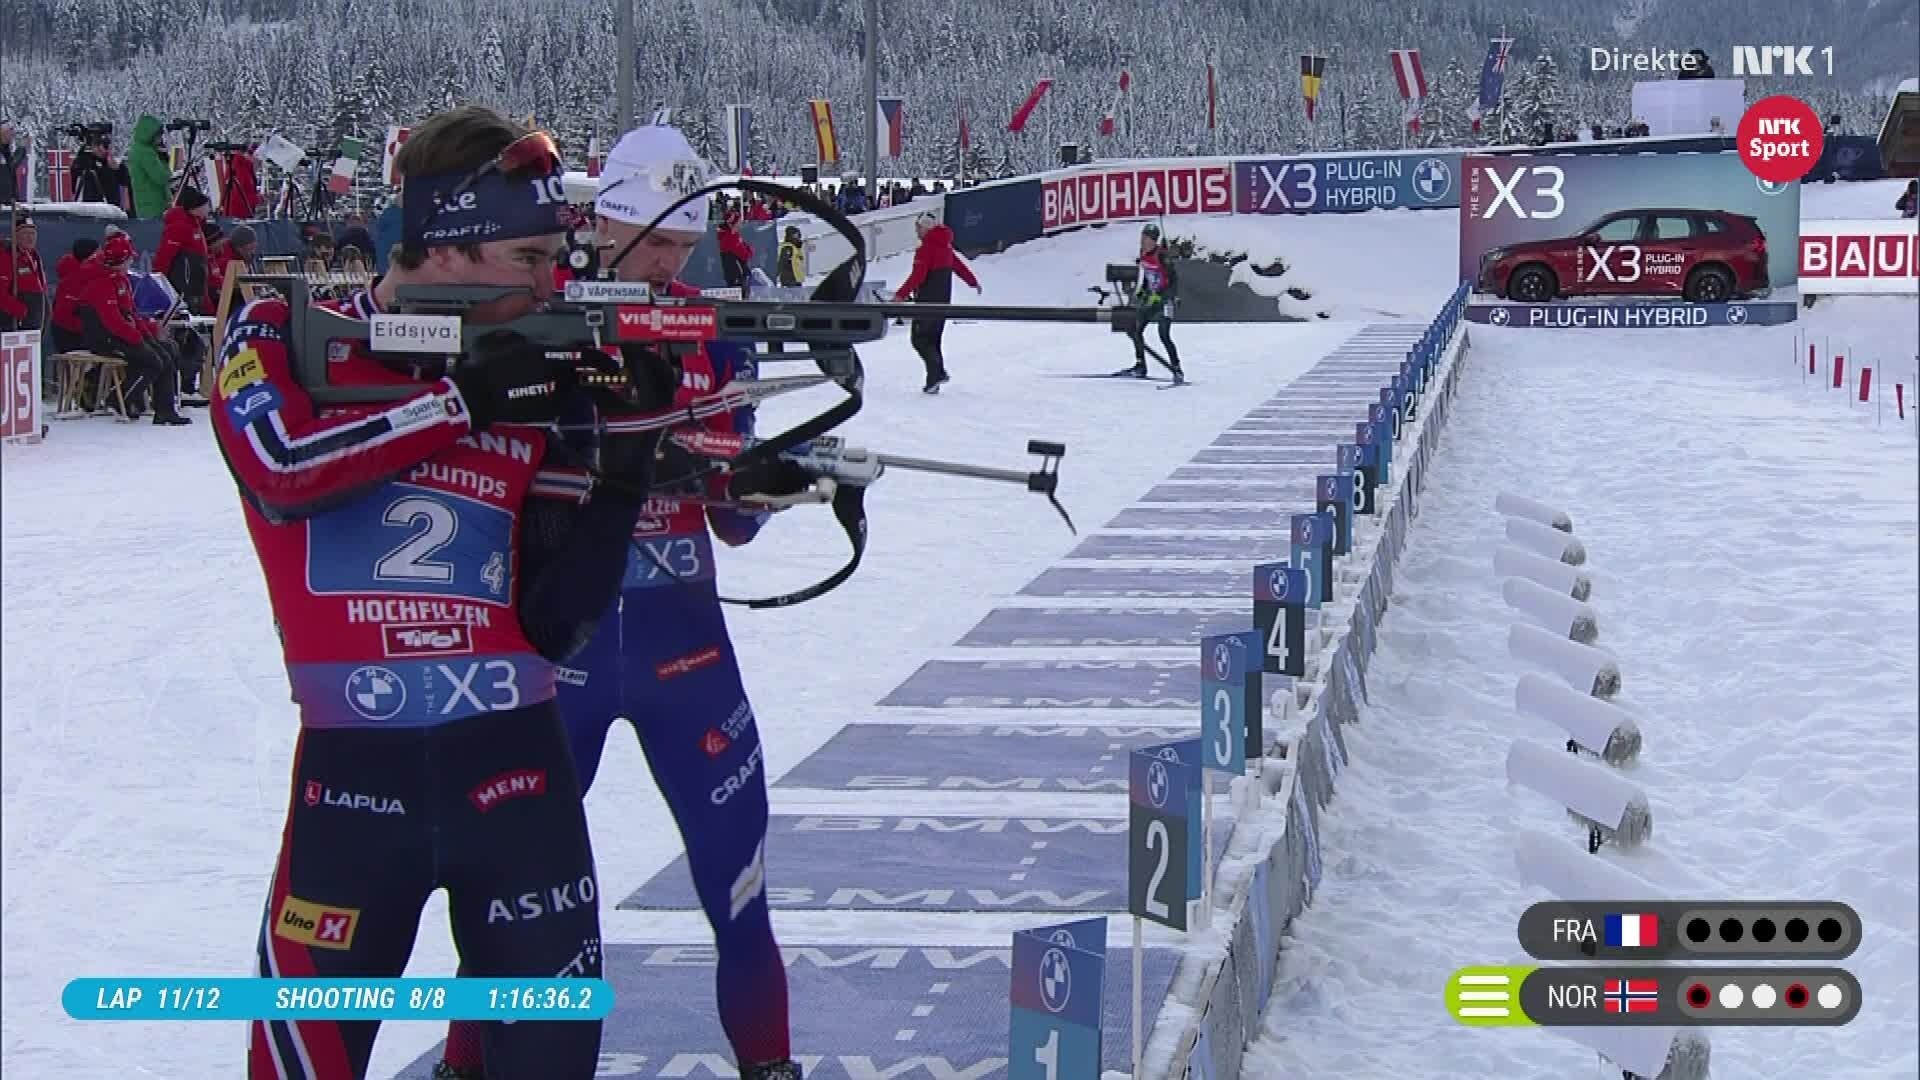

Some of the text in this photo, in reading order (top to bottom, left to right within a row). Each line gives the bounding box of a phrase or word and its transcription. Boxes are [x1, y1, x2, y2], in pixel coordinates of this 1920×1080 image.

[1259, 164, 1318, 209] X3
[1326, 160, 1402, 181] PLUG-IN
[1044, 174, 1228, 222] BAUHAUS
[1326, 186, 1397, 207] HYBRID
[1470, 195, 1480, 219] THE
[1482, 166, 1565, 219] X3
[1585, 245, 1641, 282] X3
[1645, 253, 1685, 263] PLUG-IN
[1645, 265, 1682, 275] HYBRID
[1529, 307, 1708, 326] PLUG-IN HYBRID
[374, 496, 458, 583] 2
[480, 551, 506, 594] 4
[645, 538, 699, 579] X3
[347, 600, 491, 628] HOCHFILZEN
[1267, 607, 1289, 671] 4
[437, 660, 520, 715] X3
[1214, 689, 1232, 767] 3
[324, 788, 406, 815] LAPUA
[478, 774, 540, 805] MENY
[1145, 819, 1169, 919] 2
[283, 910, 315, 931] Uno
